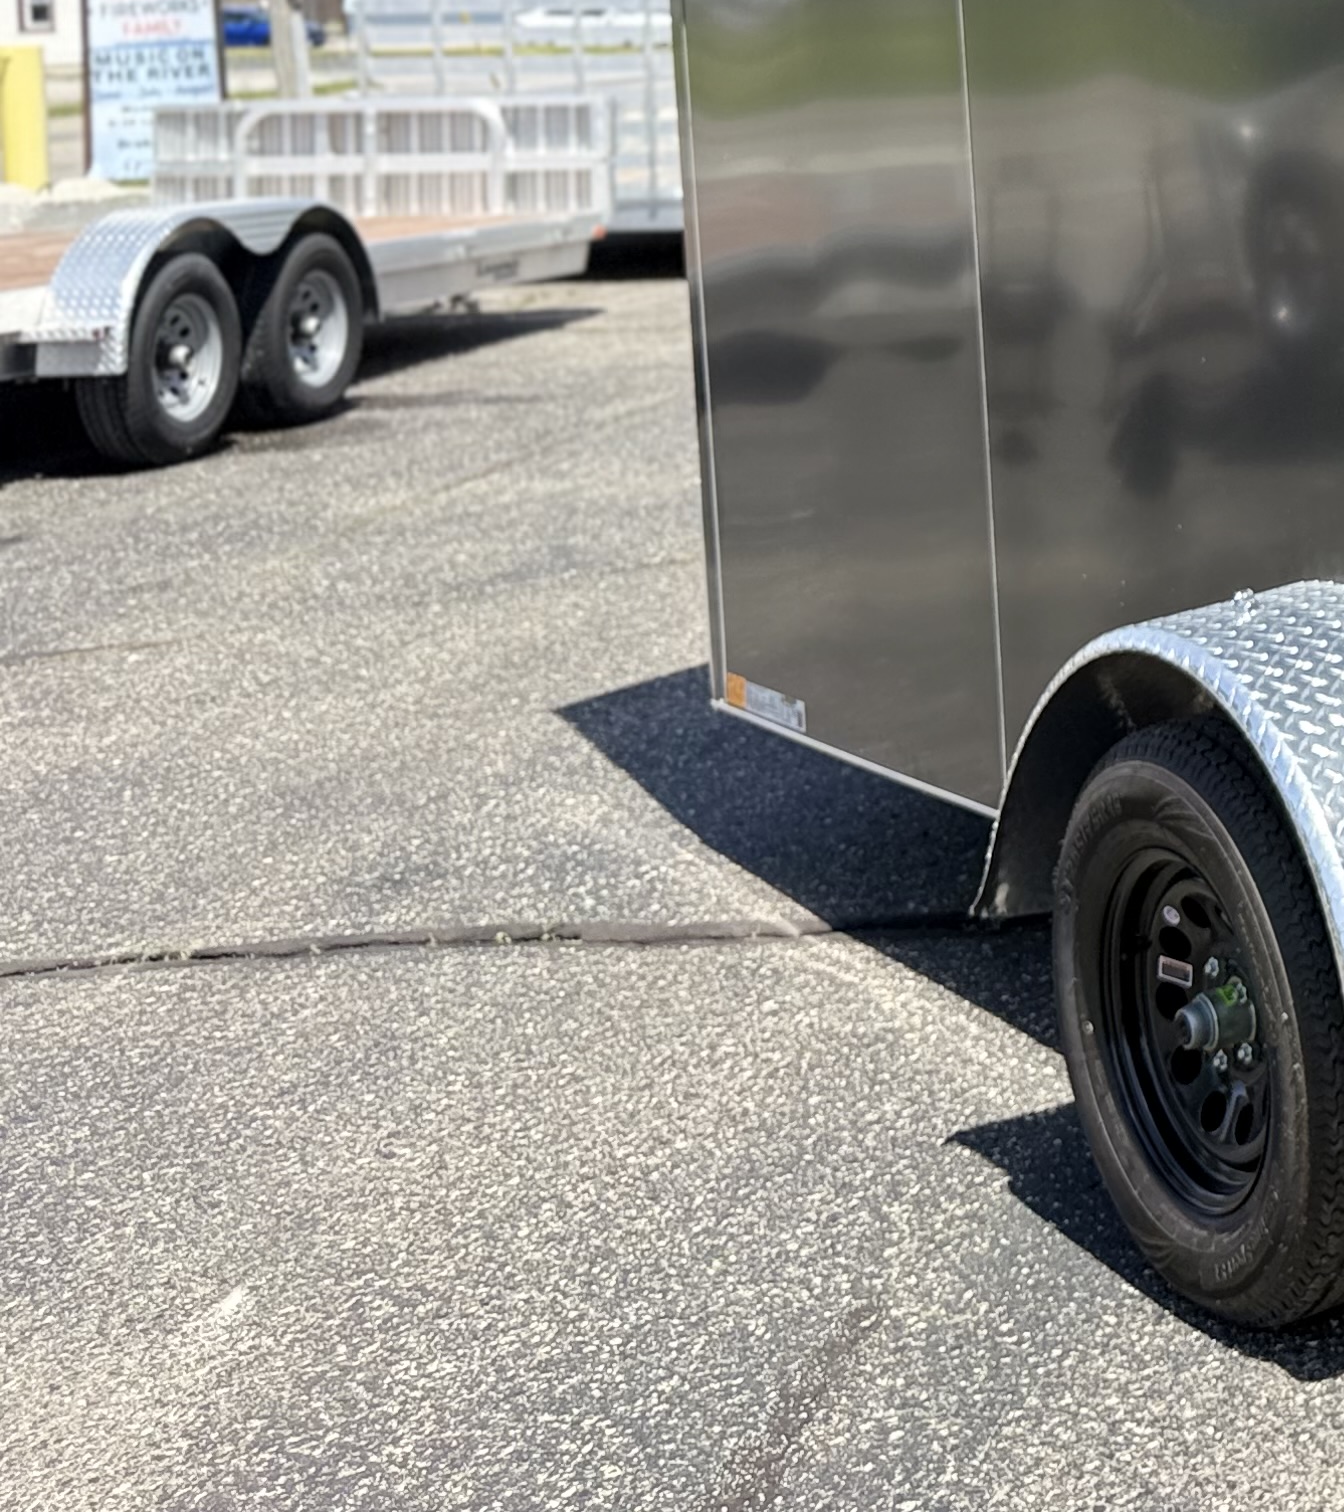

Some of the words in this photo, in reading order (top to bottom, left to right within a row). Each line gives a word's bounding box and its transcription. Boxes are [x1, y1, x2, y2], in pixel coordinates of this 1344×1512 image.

[95, 49, 169, 66] MUSIC
[176, 47, 205, 63] ON
[93, 69, 137, 83] THE
[146, 64, 210, 80] RIVER
